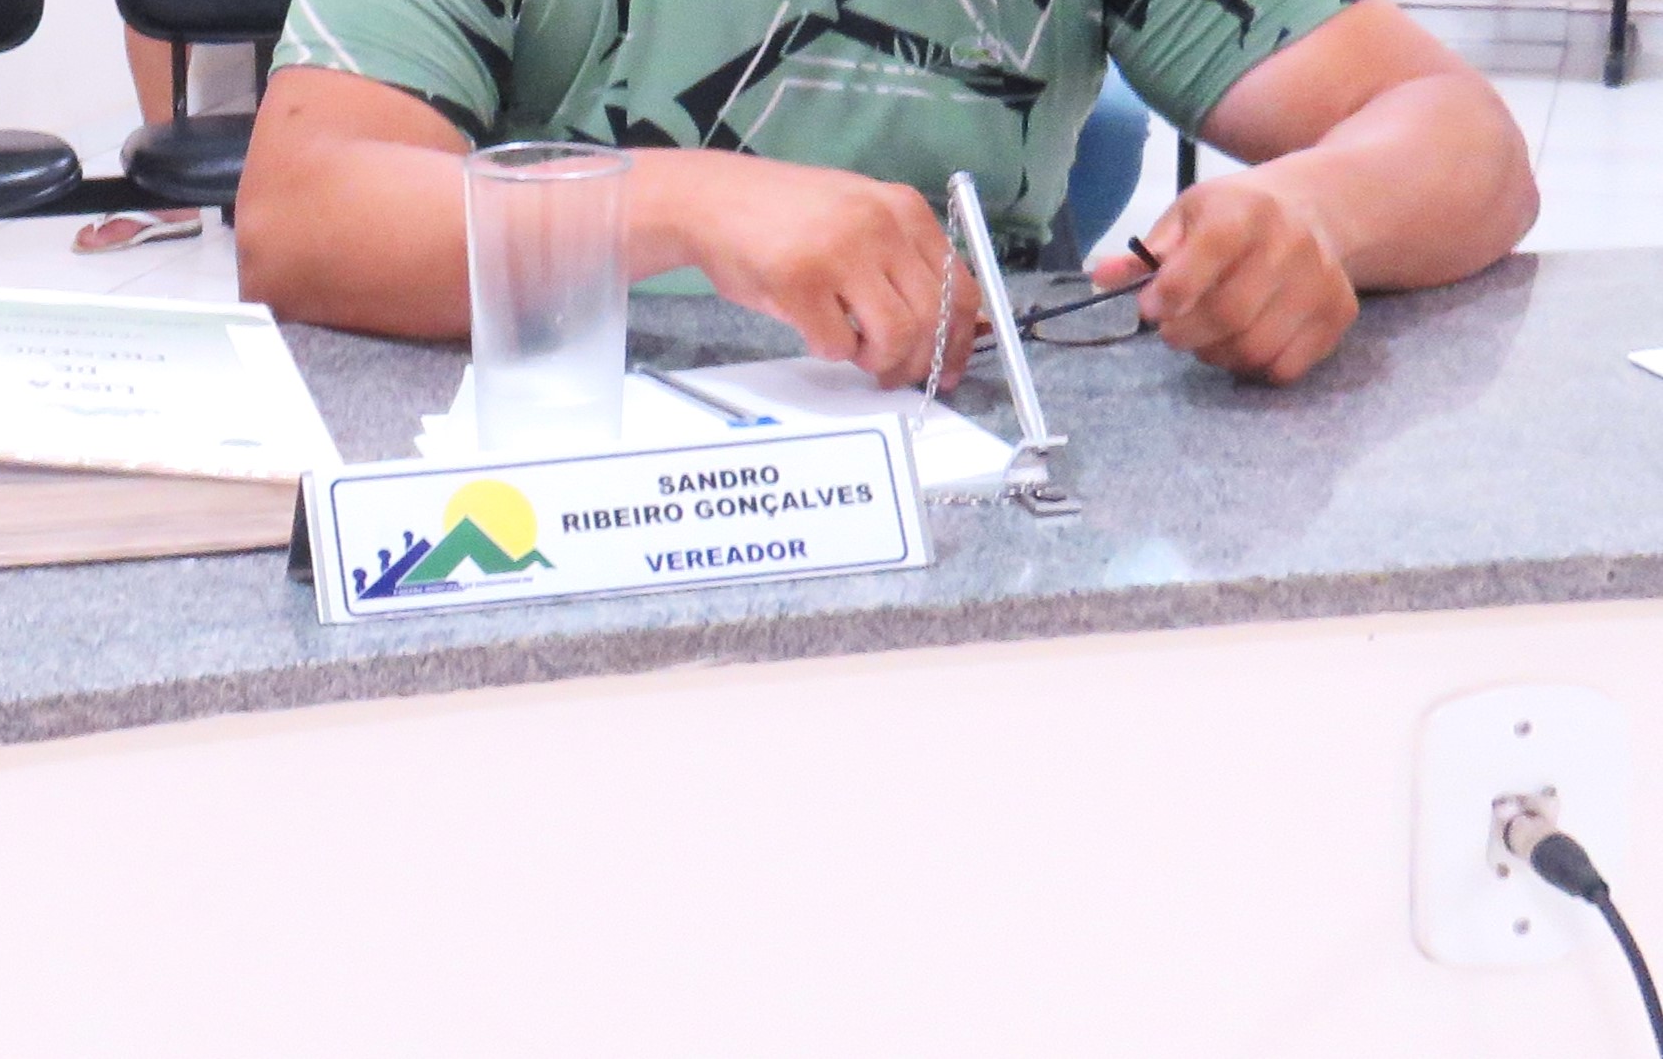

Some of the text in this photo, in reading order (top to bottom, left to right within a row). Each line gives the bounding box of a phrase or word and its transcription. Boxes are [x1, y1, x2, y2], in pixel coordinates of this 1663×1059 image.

[657, 464, 781, 496] SANDRO
[560, 482, 875, 534] RIBEIRO GONÇALVES
[644, 538, 809, 574] VEREADOR
